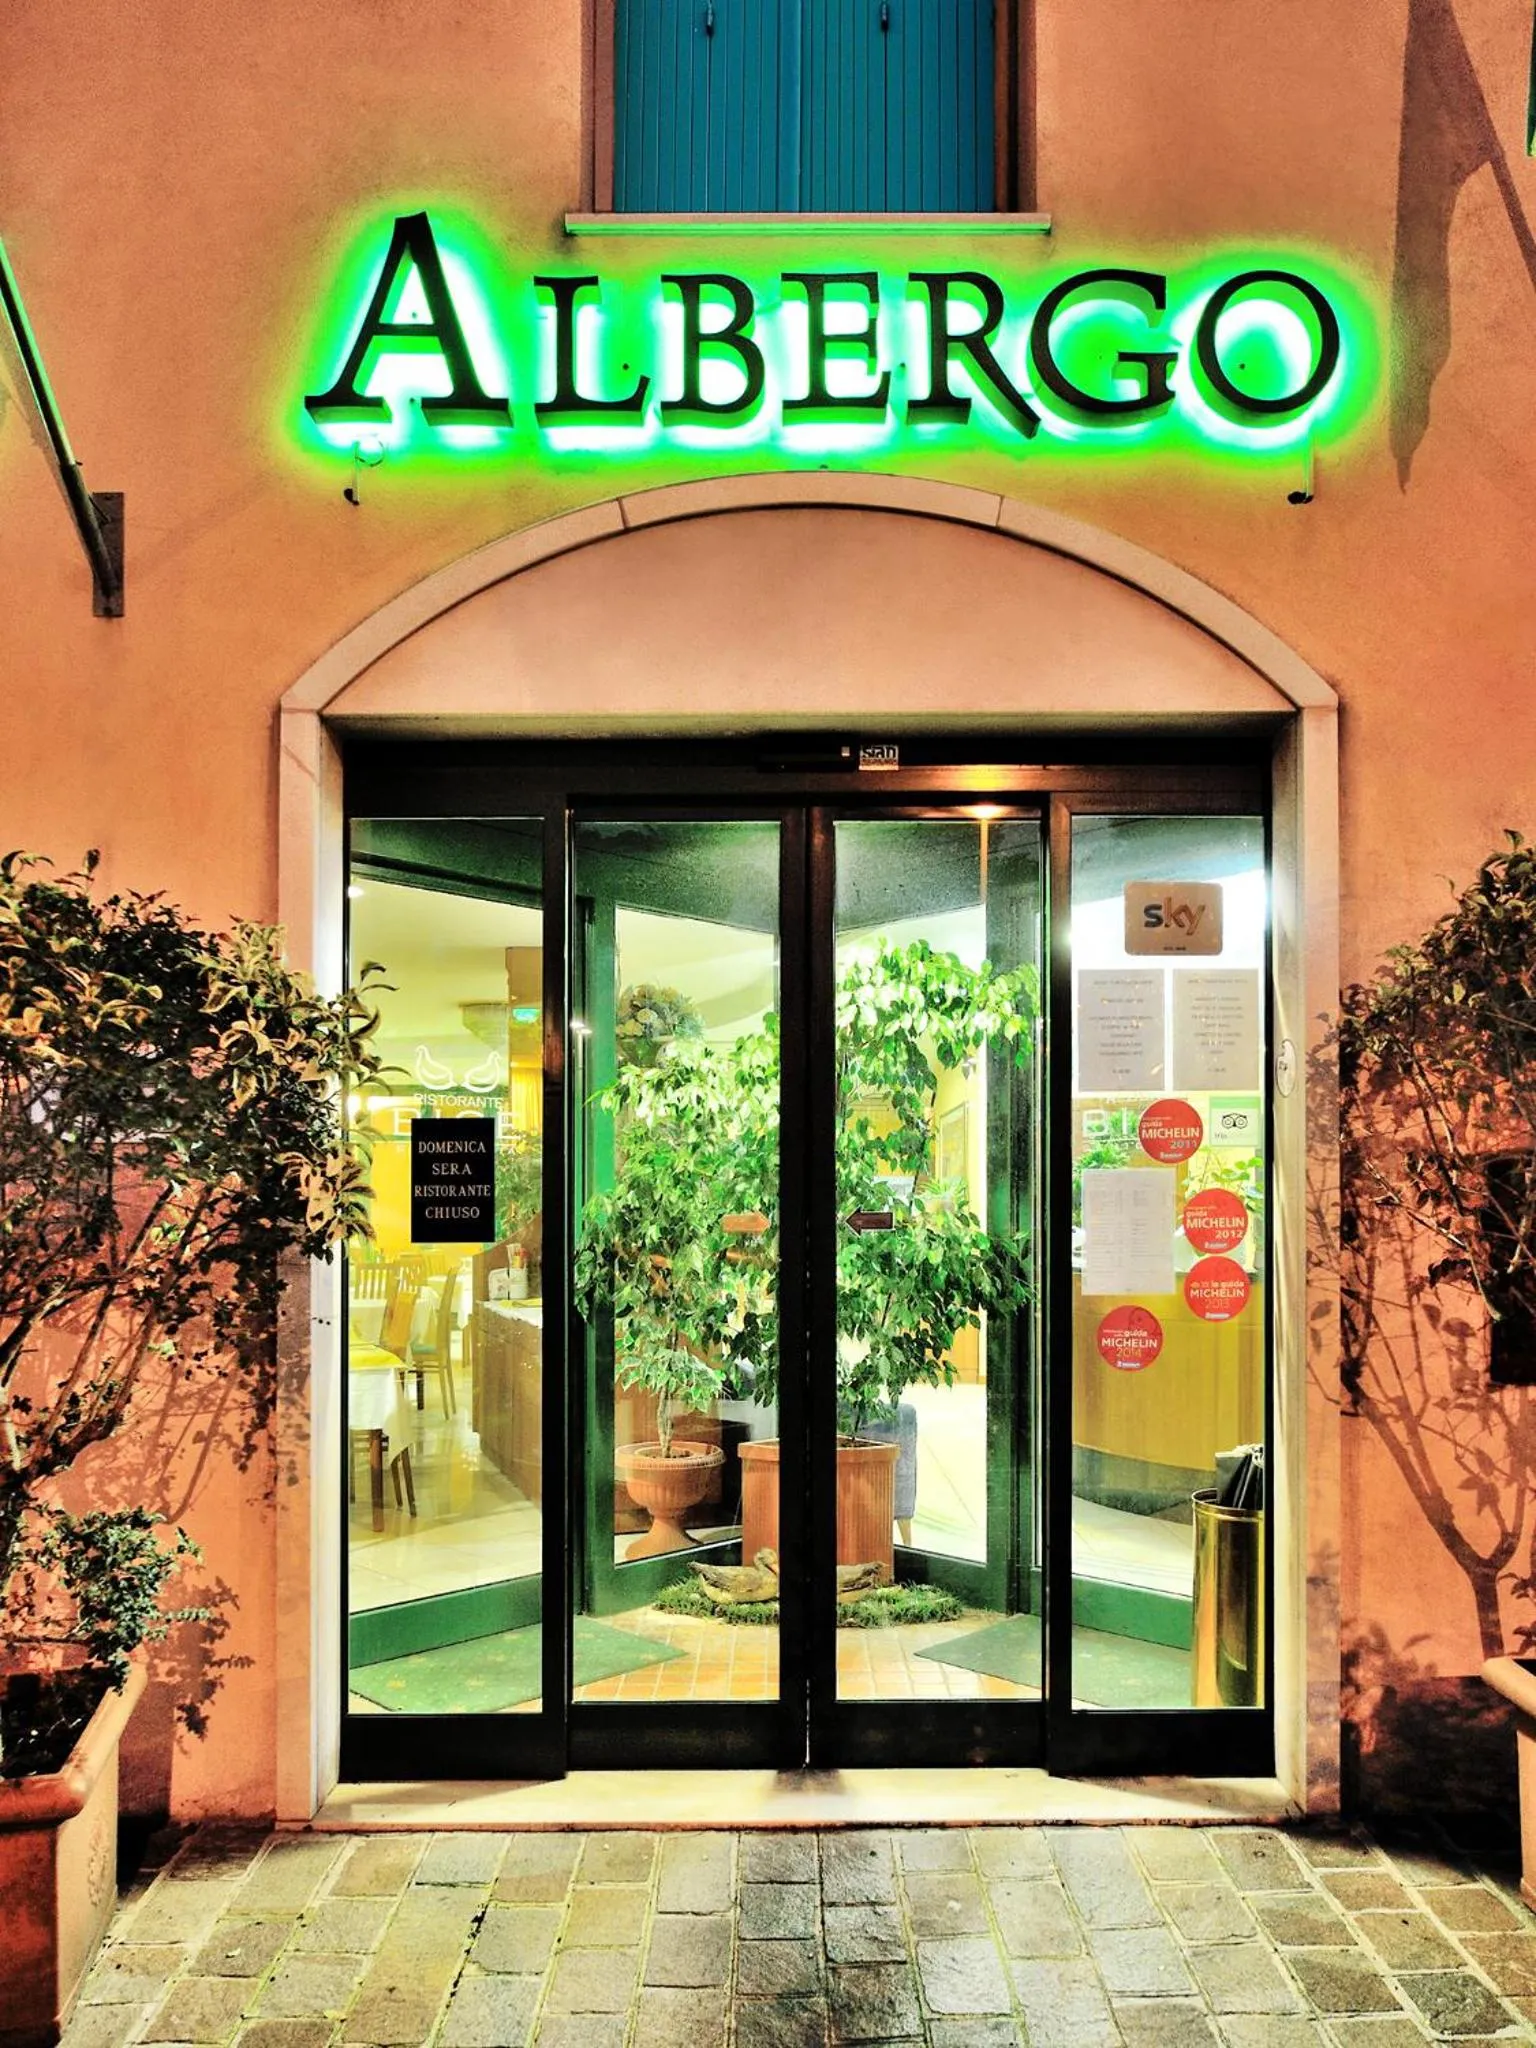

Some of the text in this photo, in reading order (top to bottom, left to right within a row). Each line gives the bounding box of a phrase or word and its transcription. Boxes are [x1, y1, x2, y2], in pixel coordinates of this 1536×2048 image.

[305, 212, 1341, 437] ALBERGO
[1143, 897, 1206, 936] sky
[414, 1093, 504, 1109] RISTORANTE
[1141, 1126, 1200, 1139] MICHELIN
[418, 1140, 487, 1154] DOMENICA
[432, 1163, 473, 1176] SERA
[414, 1184, 492, 1198] RISTORANTE
[425, 1206, 481, 1219] CHIUSO
[1186, 1217, 1245, 1229] MICHELIN
[1215, 1229, 1244, 1239] 2012
[1190, 1288, 1245, 1299] MICHELIN
[1123, 1329, 1148, 1338] guida
[1101, 1337, 1158, 1348] MICHELIN
